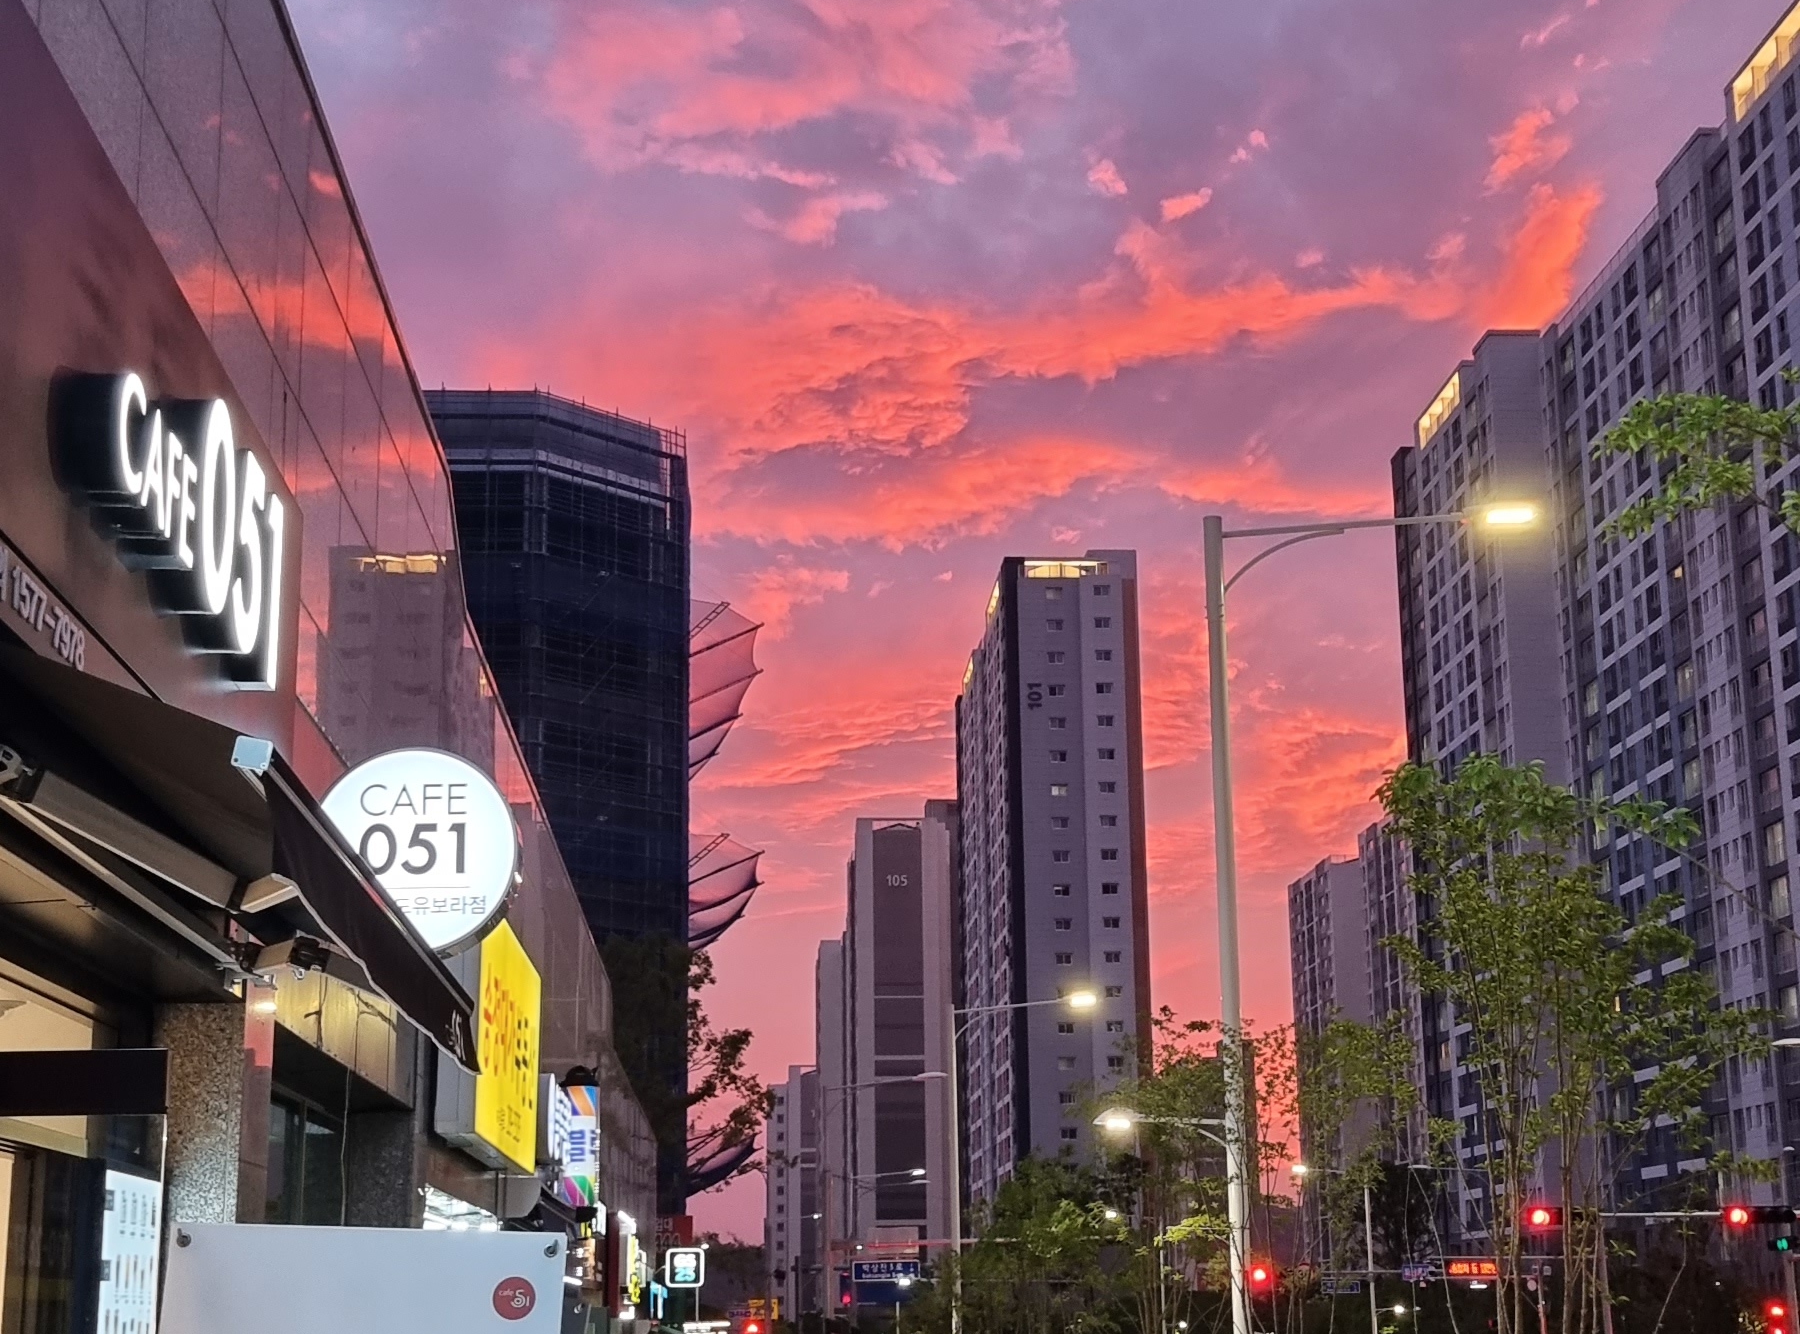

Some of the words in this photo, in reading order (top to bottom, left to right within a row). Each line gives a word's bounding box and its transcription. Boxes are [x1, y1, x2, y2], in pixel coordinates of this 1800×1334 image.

[119, 372, 198, 569] CAFE
[202, 397, 284, 692] 051
[11, 567, 85, 671] 1577-7978
[1027, 682, 1042, 710] 101
[360, 783, 468, 816] CAFE
[359, 822, 466, 876] 051
[886, 874, 908, 887] 105
